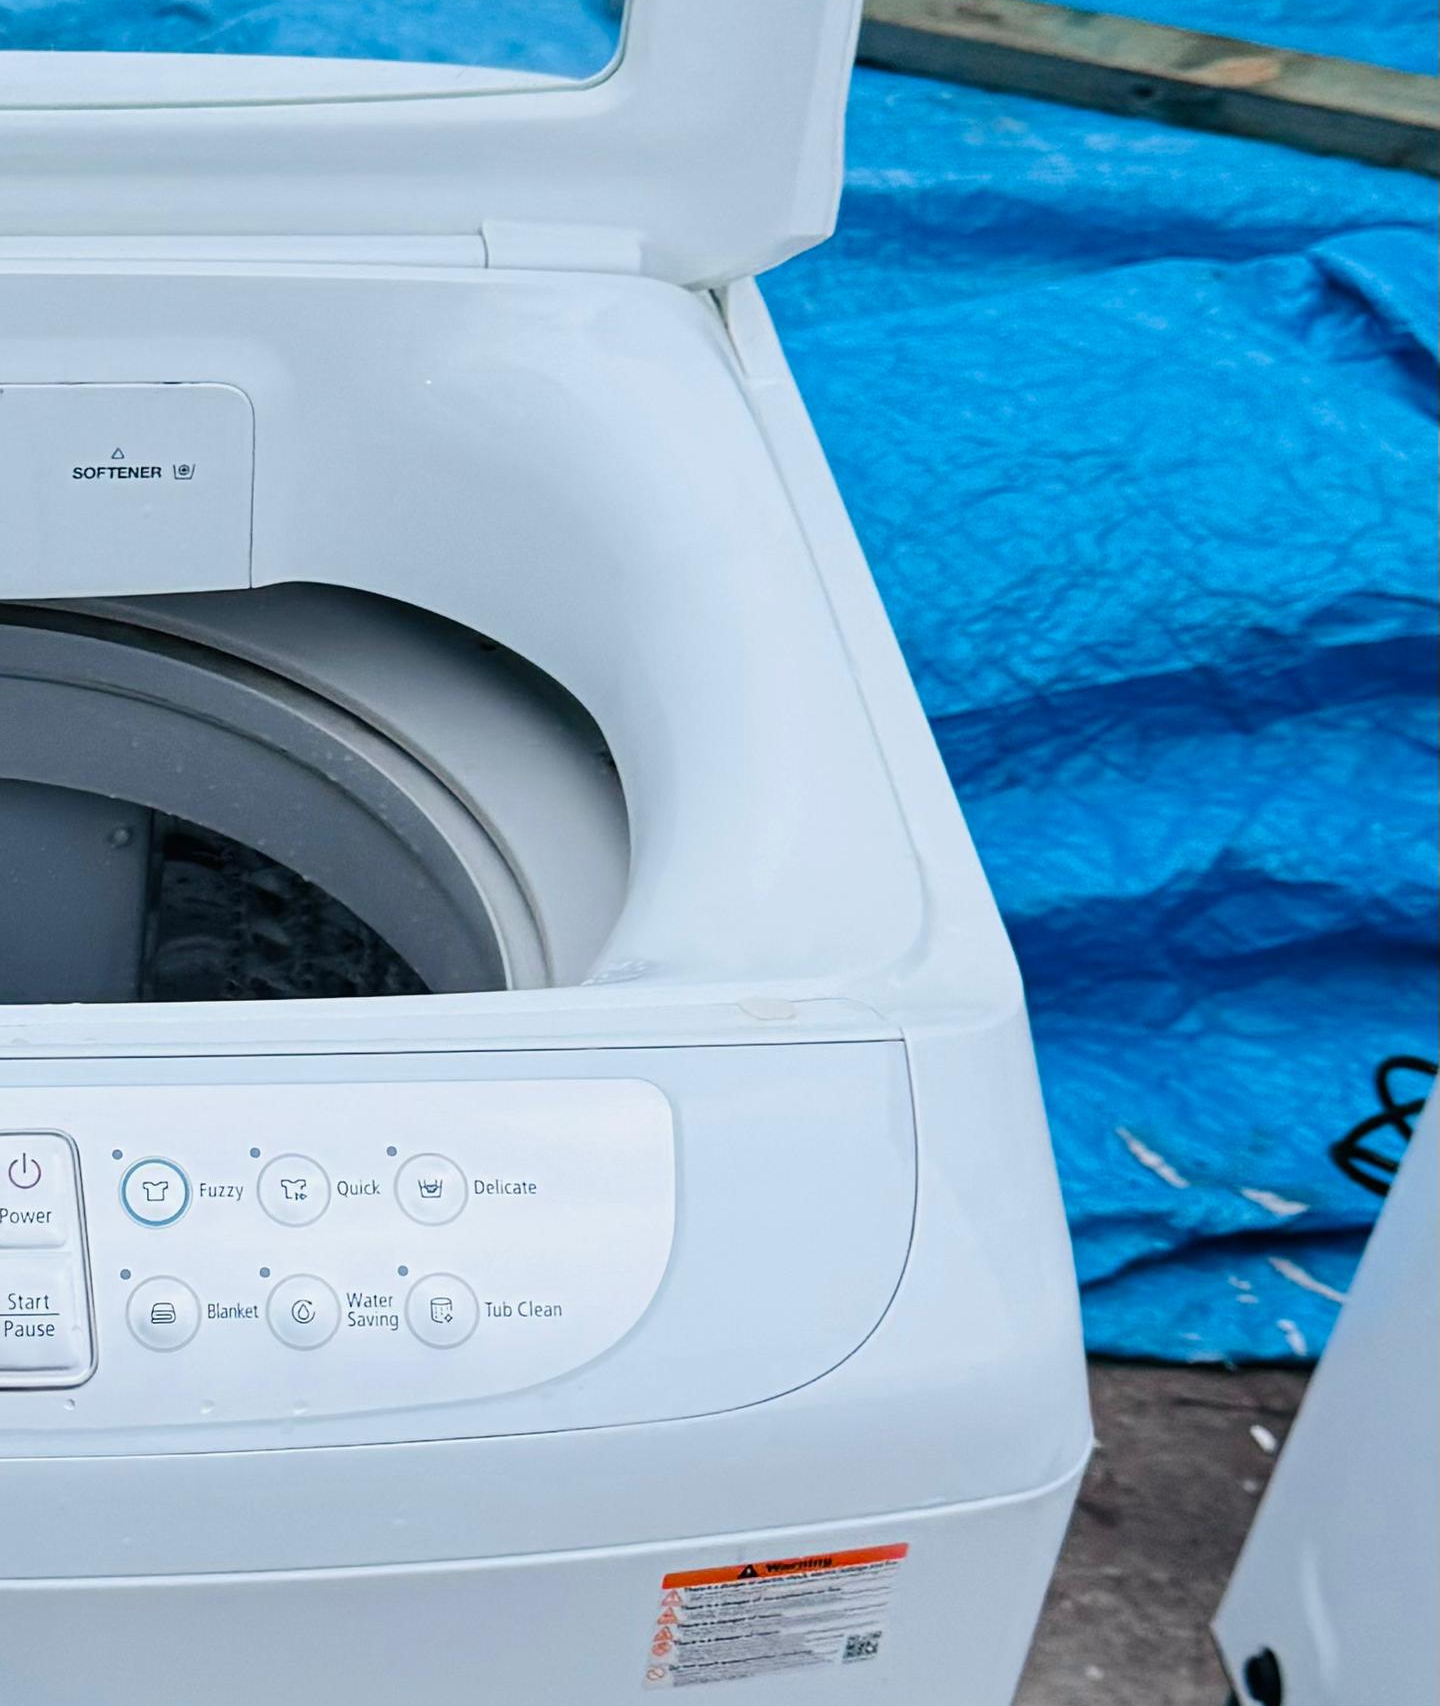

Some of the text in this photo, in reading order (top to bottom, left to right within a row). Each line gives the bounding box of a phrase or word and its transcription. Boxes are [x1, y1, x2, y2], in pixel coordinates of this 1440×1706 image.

[72, 465, 162, 480] SOFTENER
[199, 1182, 244, 1201] Fuzzy
[337, 1179, 381, 1197] Quick
[474, 1179, 537, 1195] Delicate
[0, 1208, 52, 1224] Power
[7, 1293, 50, 1311] Start
[346, 1292, 394, 1309] Water
[485, 1300, 563, 1317] Tub Clean
[207, 1303, 259, 1319] Blanket
[3, 1320, 56, 1338] Pause
[347, 1311, 399, 1331] Saving
[766, 1557, 833, 1573] Warning
